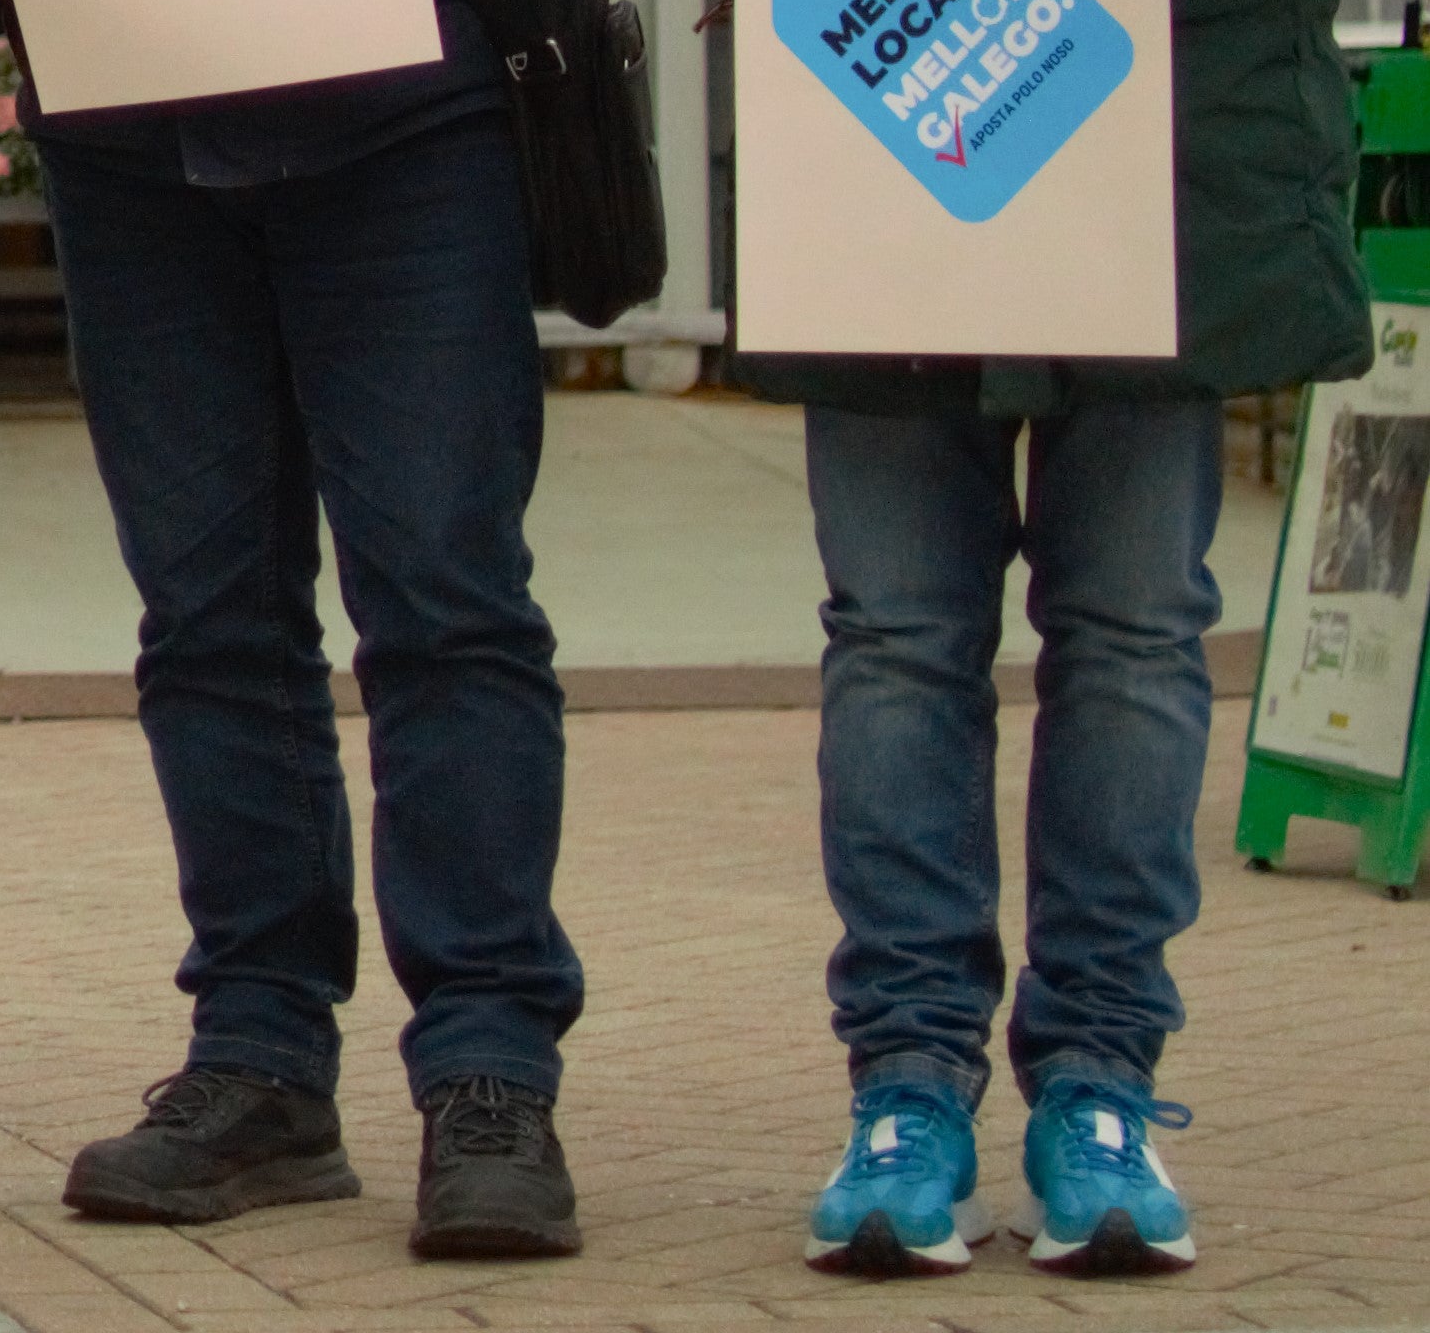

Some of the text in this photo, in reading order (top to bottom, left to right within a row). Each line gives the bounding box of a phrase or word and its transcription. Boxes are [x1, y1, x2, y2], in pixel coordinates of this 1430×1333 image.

[969, 36, 1075, 152] APOSTA POLO NOSO
